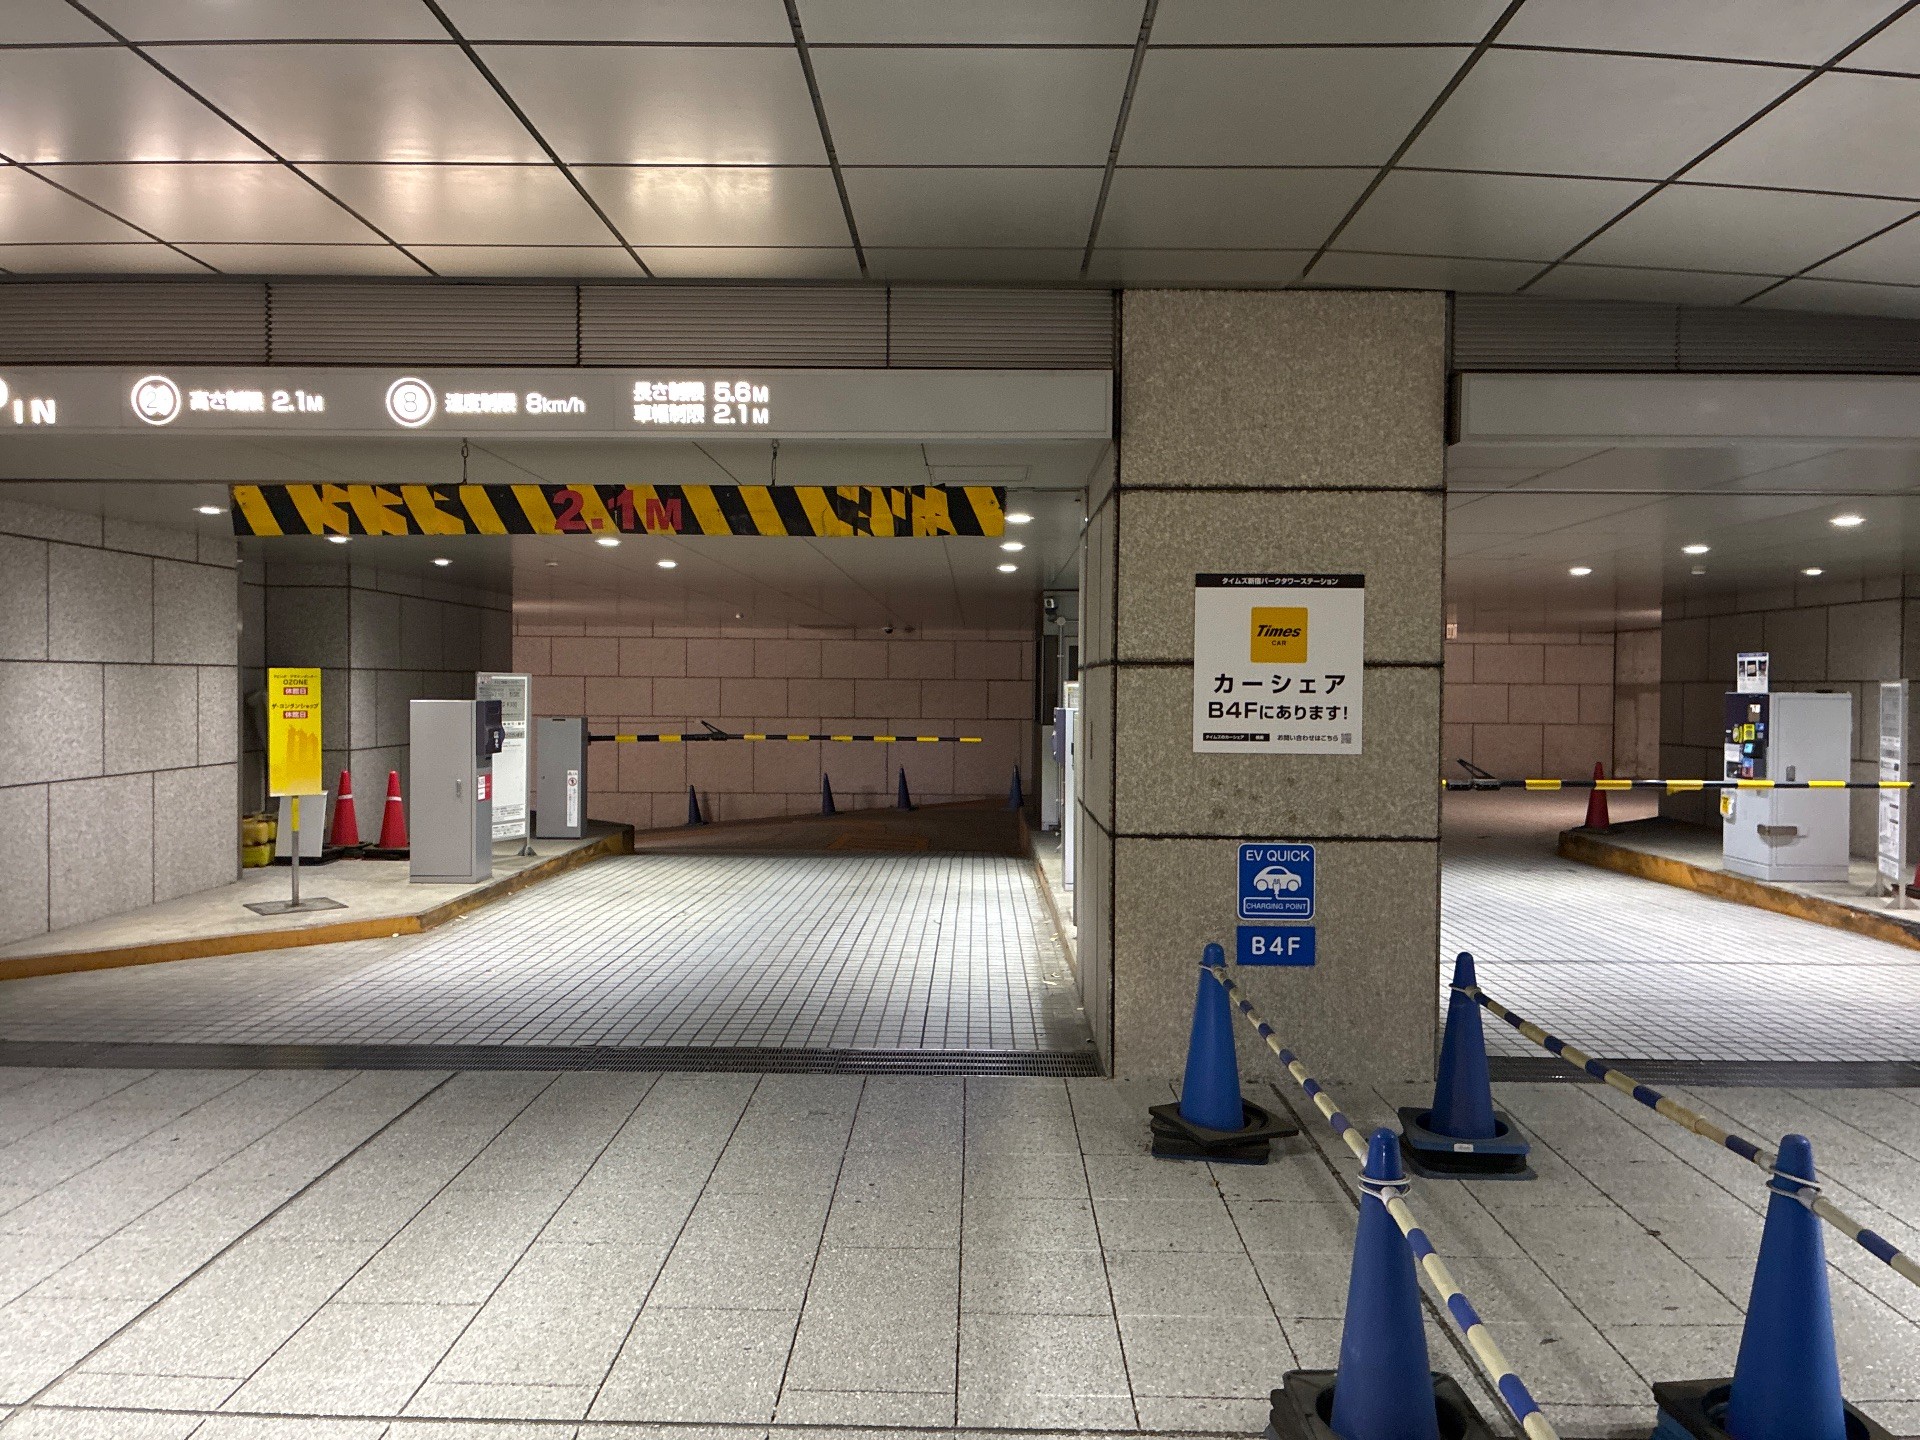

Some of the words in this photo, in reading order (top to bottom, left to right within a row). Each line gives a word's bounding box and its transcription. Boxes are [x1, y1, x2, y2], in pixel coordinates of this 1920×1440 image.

[272, 390, 325, 412] 2.1M
[525, 392, 586, 414] 8km/h
[13, 398, 56, 425] IN
[552, 489, 683, 531] 2.1M
[1256, 624, 1302, 638] Times
[1213, 673, 1346, 694] カーシェア
[1208, 701, 1348, 721] B4Fにあります!
[1277, 734, 1339, 742] お問い合わせはこちら
[1246, 850, 1263, 861] EV
[1266, 850, 1310, 862] QUICK
[1246, 902, 1284, 910] CHARGING
[1285, 902, 1307, 910] POINT
[1251, 936, 1301, 956] B4F
